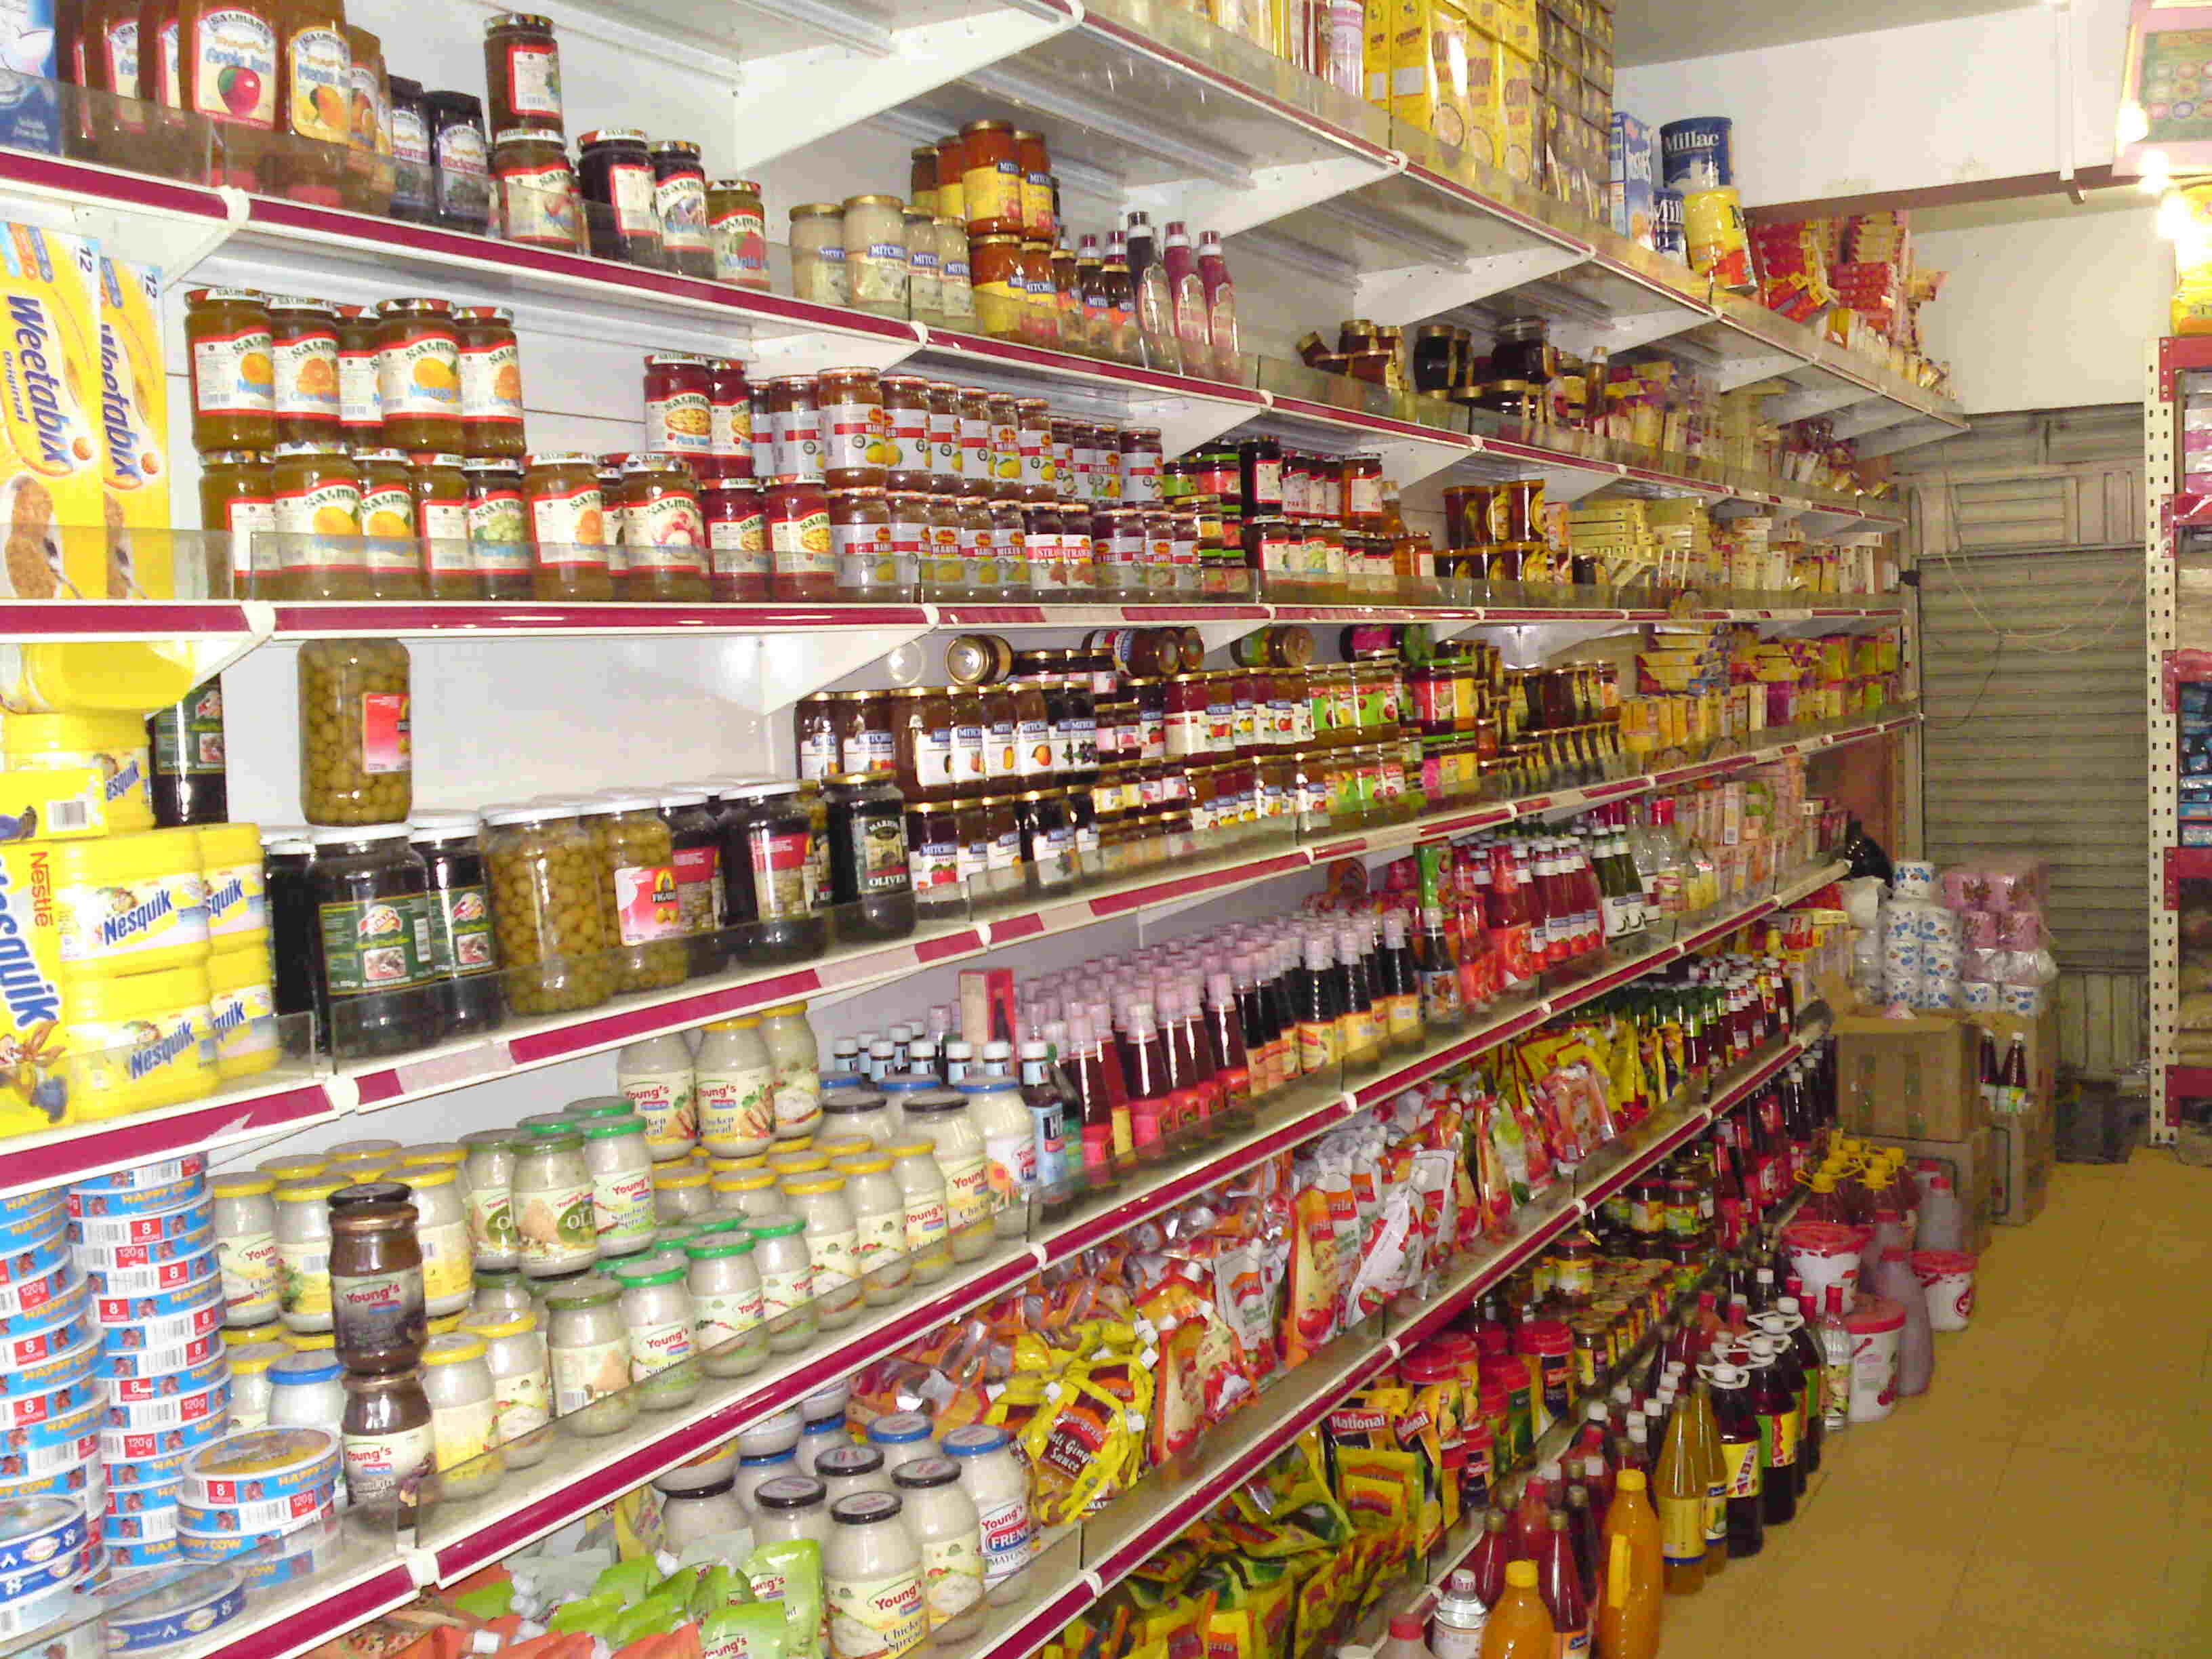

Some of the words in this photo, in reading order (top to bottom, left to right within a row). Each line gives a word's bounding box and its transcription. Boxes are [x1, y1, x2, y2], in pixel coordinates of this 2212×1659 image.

[79, 244, 93, 273] 12
[144, 274, 157, 300] 12
[7, 295, 74, 470] Weetabix
[103, 888, 173, 946] Nesquik
[129, 1021, 195, 1080] Nesquik
[141, 1222, 152, 1235] 8
[169, 1266, 179, 1280] 8
[346, 1284, 401, 1304] Young's
[108, 1300, 119, 1315] 8
[24, 1339, 35, 1353] 8
[24, 1398, 34, 1413] 8
[1331, 1413, 1386, 1429] National
[216, 1483, 226, 1496] 8
